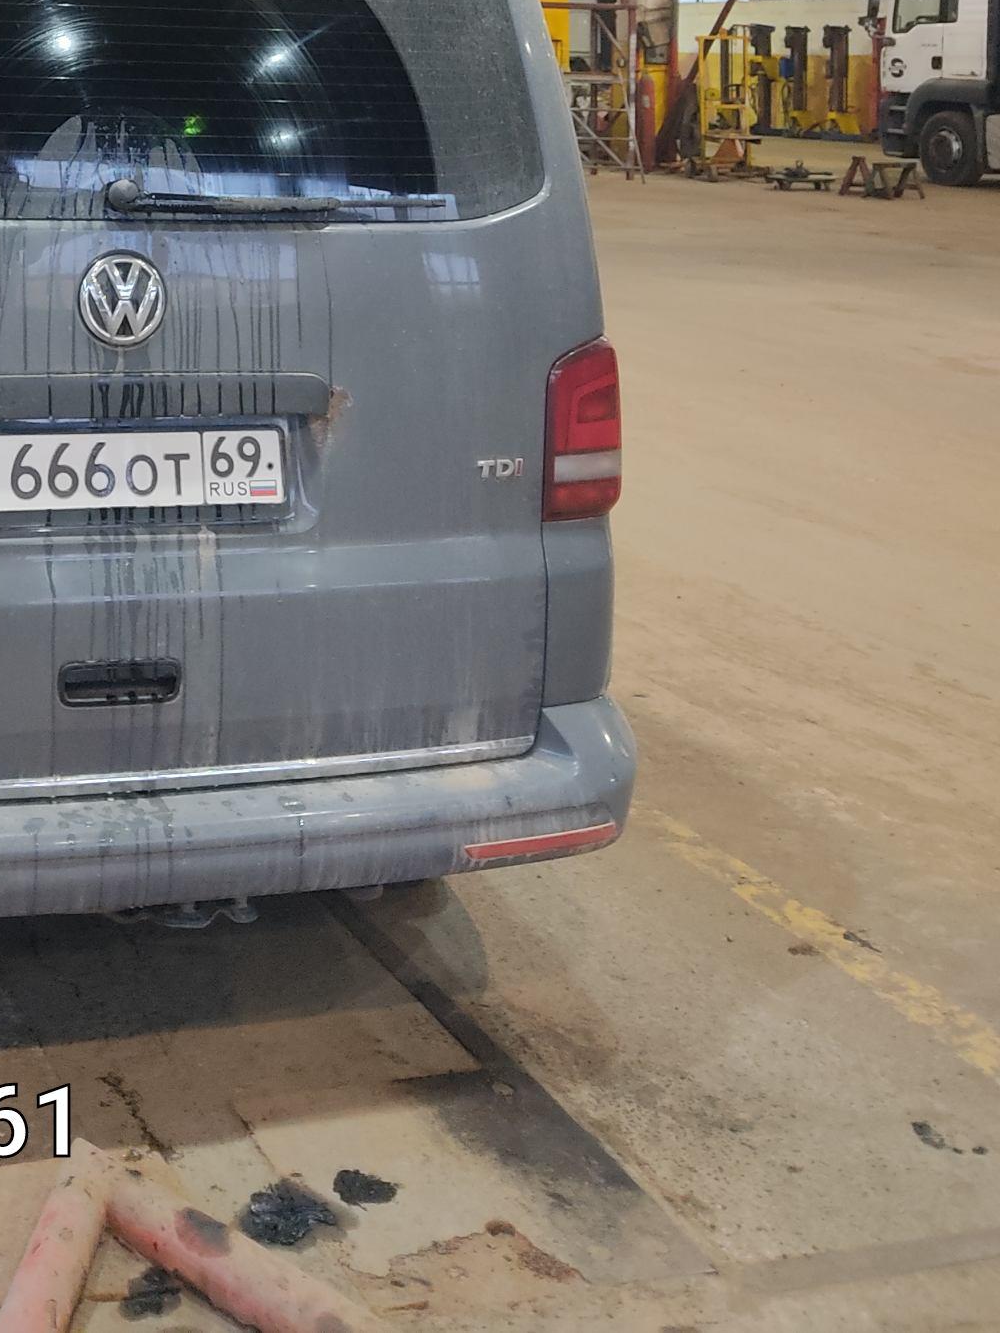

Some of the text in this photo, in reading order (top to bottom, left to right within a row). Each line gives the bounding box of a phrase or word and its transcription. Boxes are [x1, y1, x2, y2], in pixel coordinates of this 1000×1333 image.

[209, 435, 262, 479] 69
[476, 457, 524, 479] TDI
[208, 481, 249, 497] RUS
